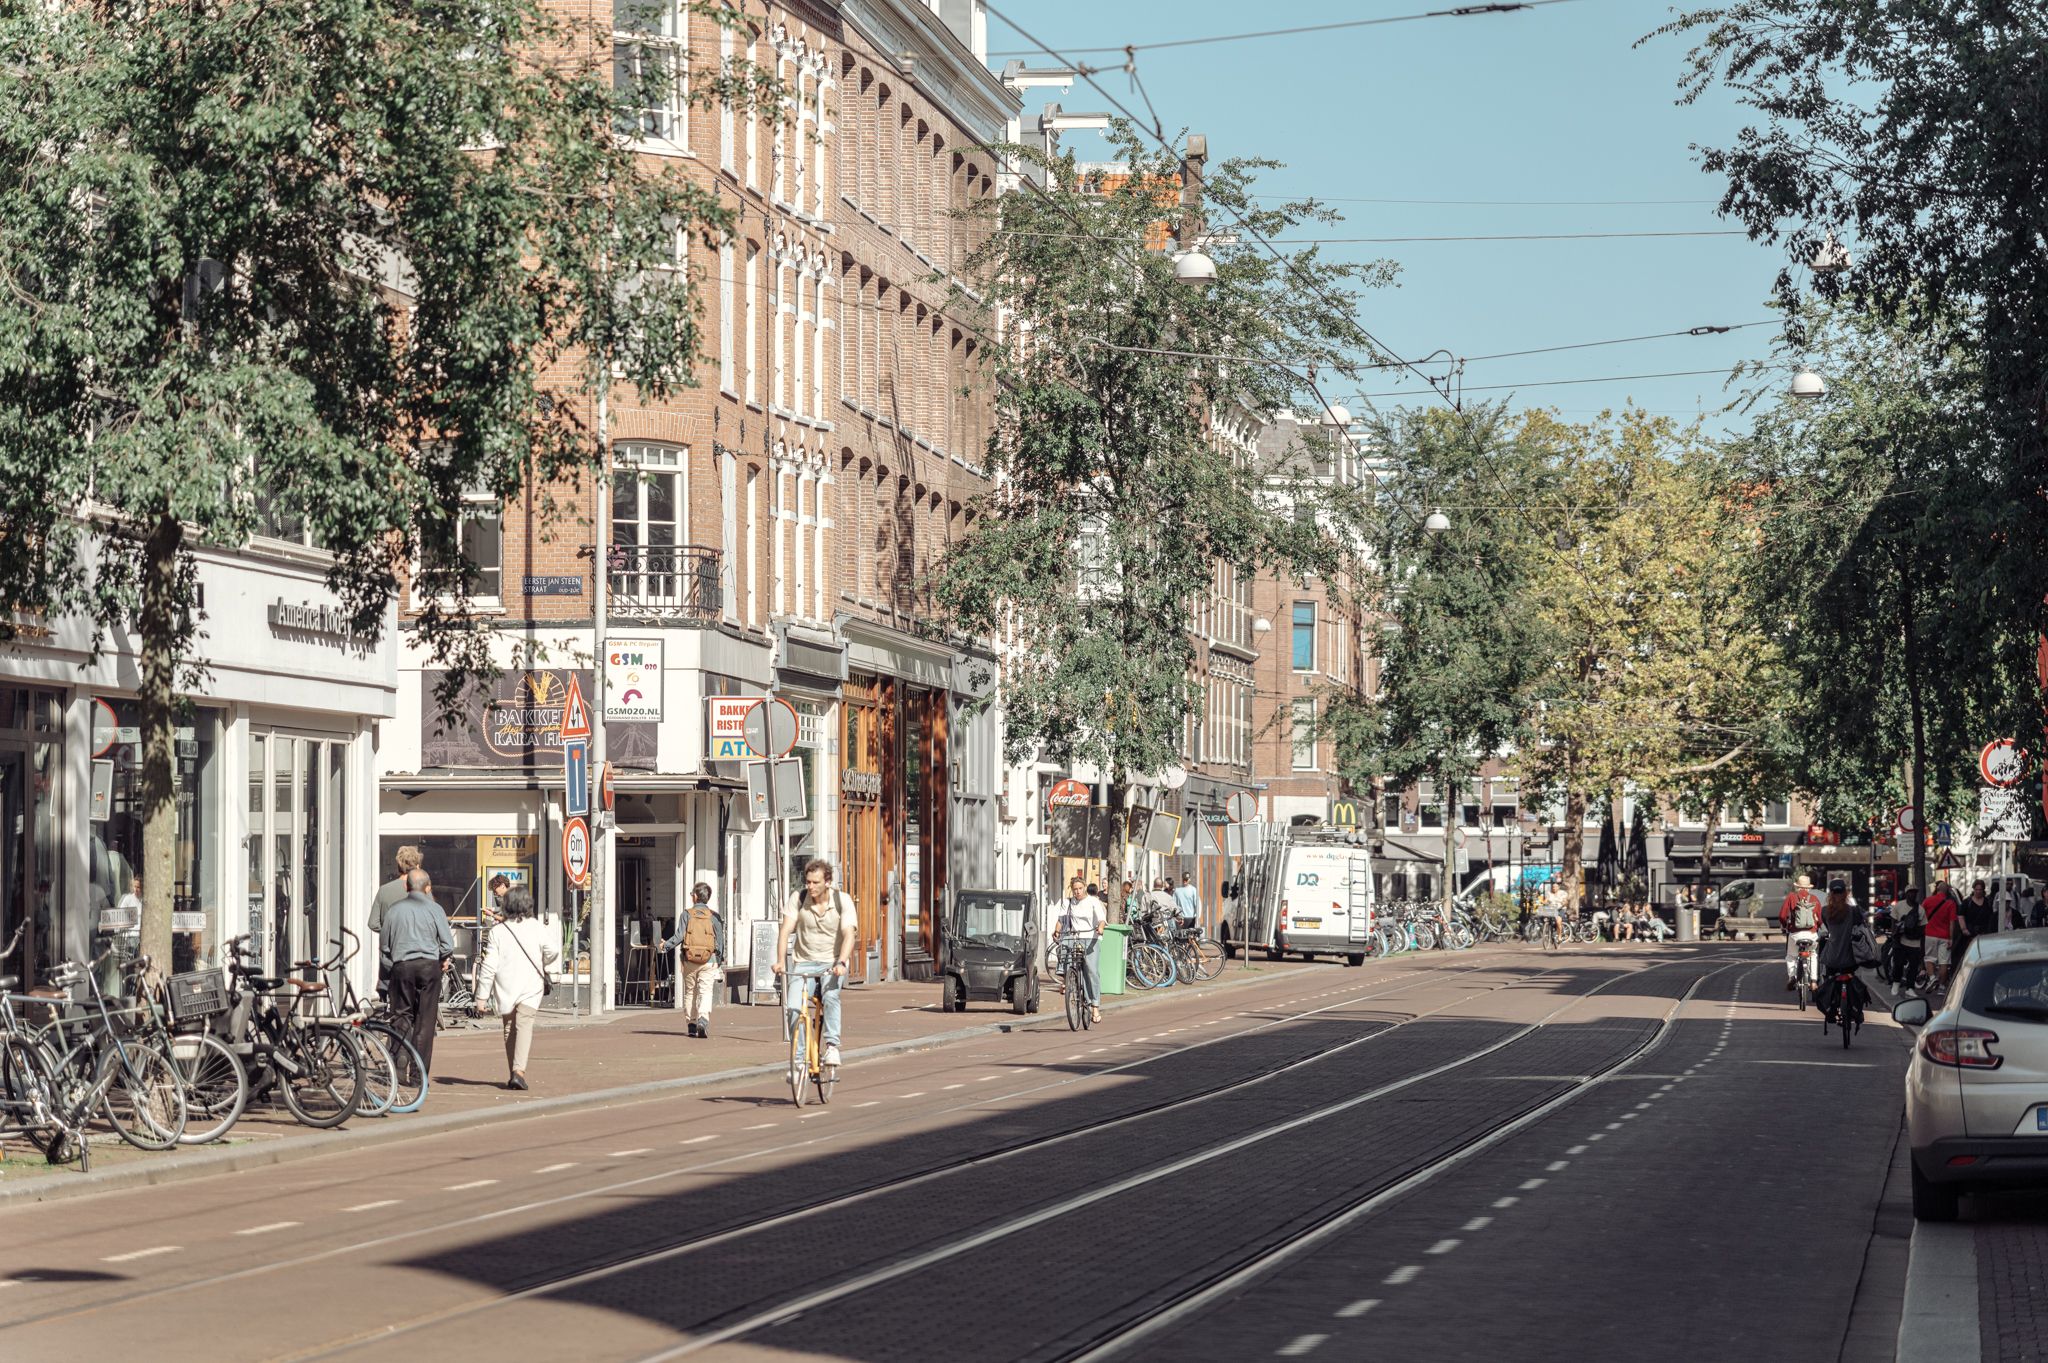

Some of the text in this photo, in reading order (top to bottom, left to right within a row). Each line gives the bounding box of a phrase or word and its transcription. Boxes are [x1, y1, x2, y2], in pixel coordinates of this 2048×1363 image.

[524, 577, 581, 587] EERSTE JAN STEEN
[277, 597, 320, 631] America
[610, 652, 644, 666] GSM
[644, 663, 658, 671] 020
[606, 707, 661, 715] GSM020.NL
[494, 732, 540, 746] KARA
[492, 836, 526, 849] ATM
[570, 834, 583, 852] 6m
